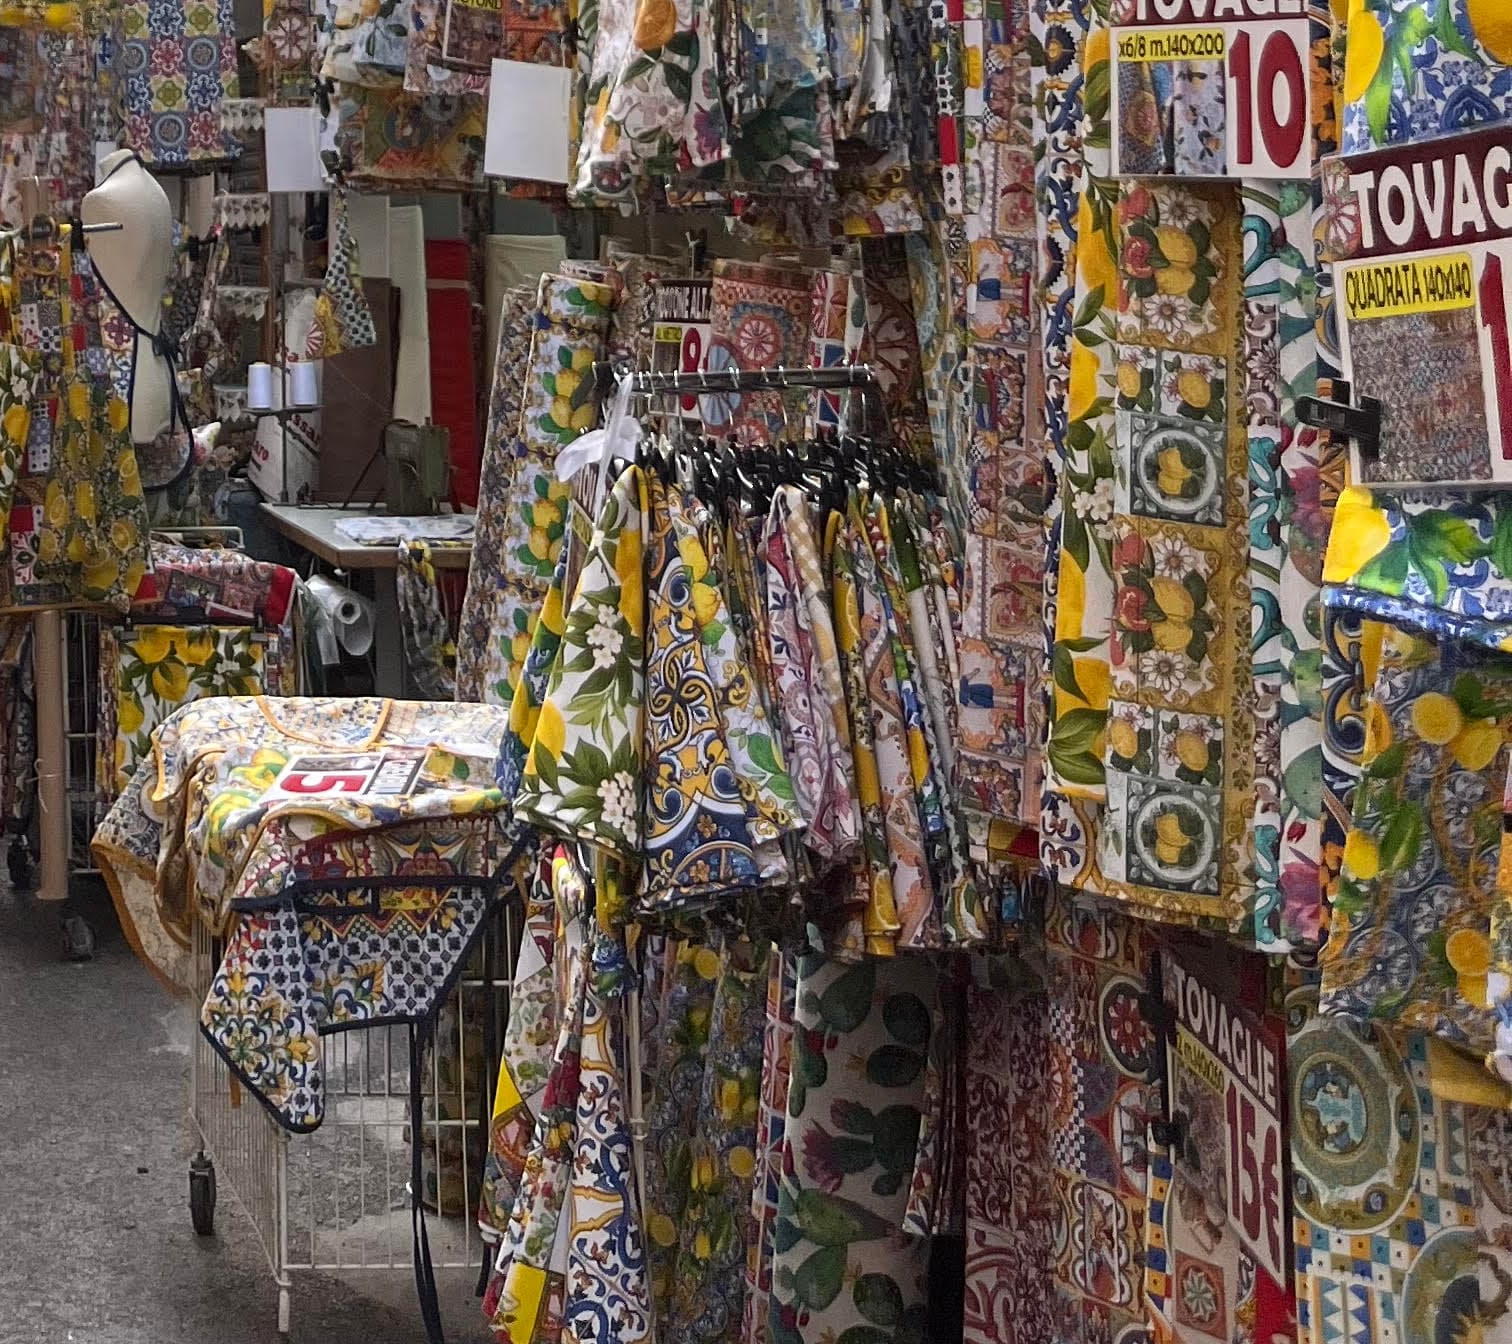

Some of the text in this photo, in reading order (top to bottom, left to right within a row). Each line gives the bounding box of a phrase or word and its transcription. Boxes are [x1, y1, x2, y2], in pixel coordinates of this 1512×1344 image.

[1119, 35, 1146, 58] x6/8
[1228, 29, 1307, 169] 10
[1349, 145, 1512, 249] TOVAG
[1345, 263, 1423, 318] QUADRATA
[1172, 963, 1277, 1111] TOVAGLIE
[1226, 1078, 1281, 1275] 15€
